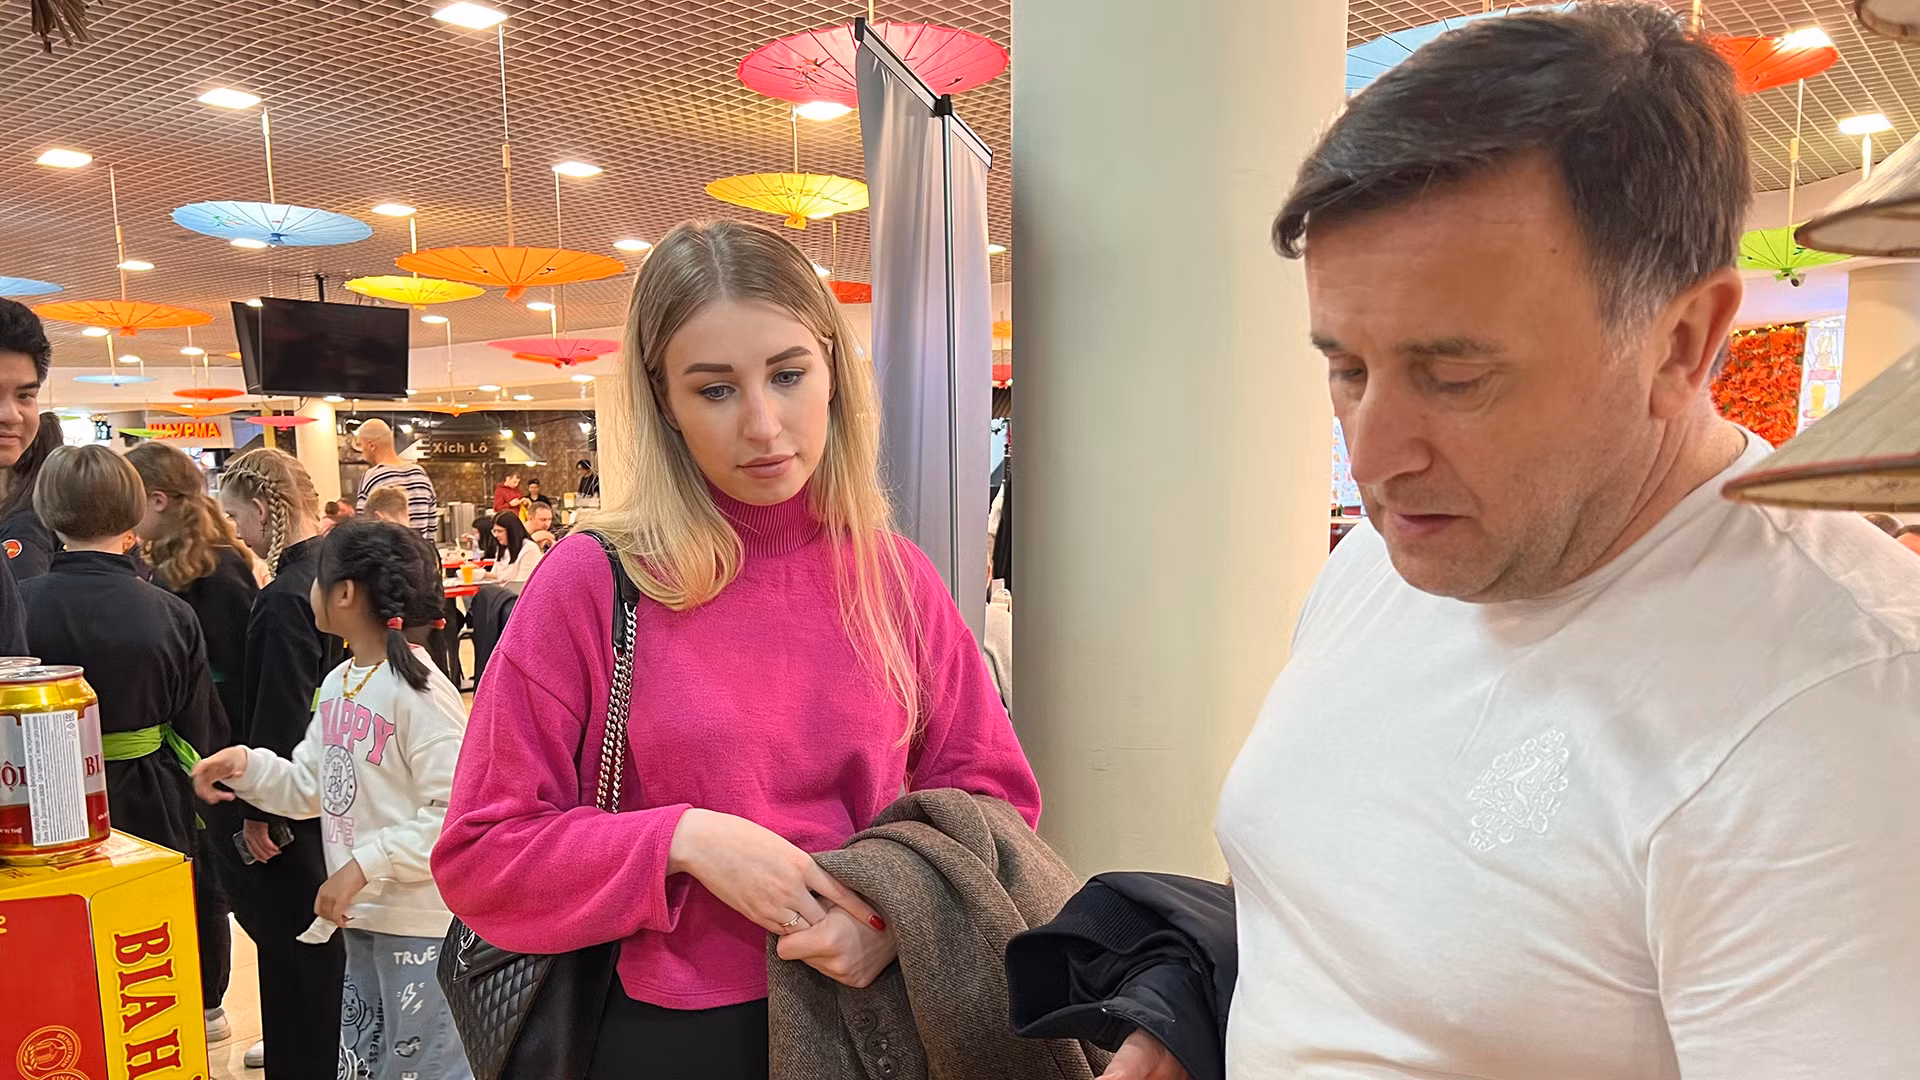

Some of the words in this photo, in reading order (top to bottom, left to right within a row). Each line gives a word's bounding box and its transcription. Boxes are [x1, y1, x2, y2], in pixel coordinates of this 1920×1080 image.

[432, 441, 465, 454] Xích
[0, 760, 27, 792] ỘI
[393, 945, 438, 966] TRUE
